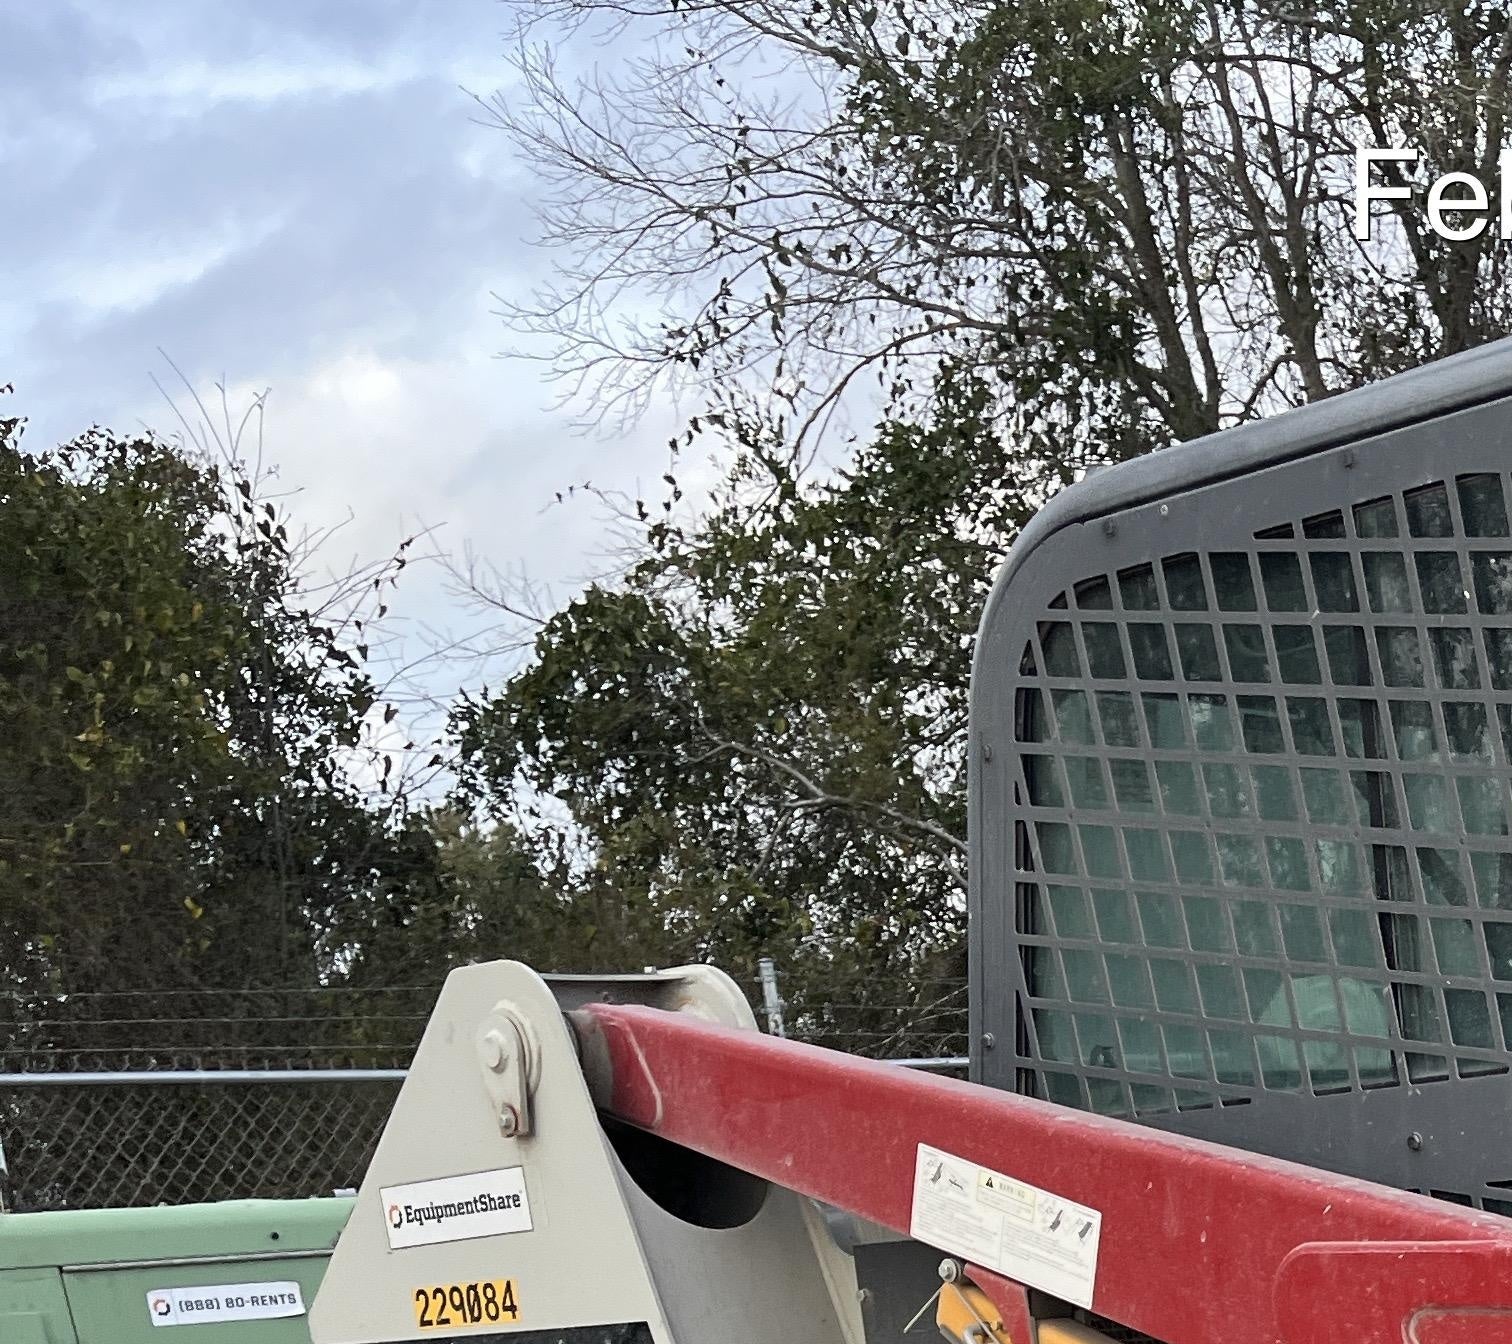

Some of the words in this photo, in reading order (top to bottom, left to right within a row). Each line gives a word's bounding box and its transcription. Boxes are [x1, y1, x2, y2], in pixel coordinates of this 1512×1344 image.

[404, 1193, 521, 1226] EquipmentShare
[178, 1297, 221, 1313] (888)
[225, 1293, 297, 1309] 80-RENTS
[415, 1280, 518, 1328] 229084
